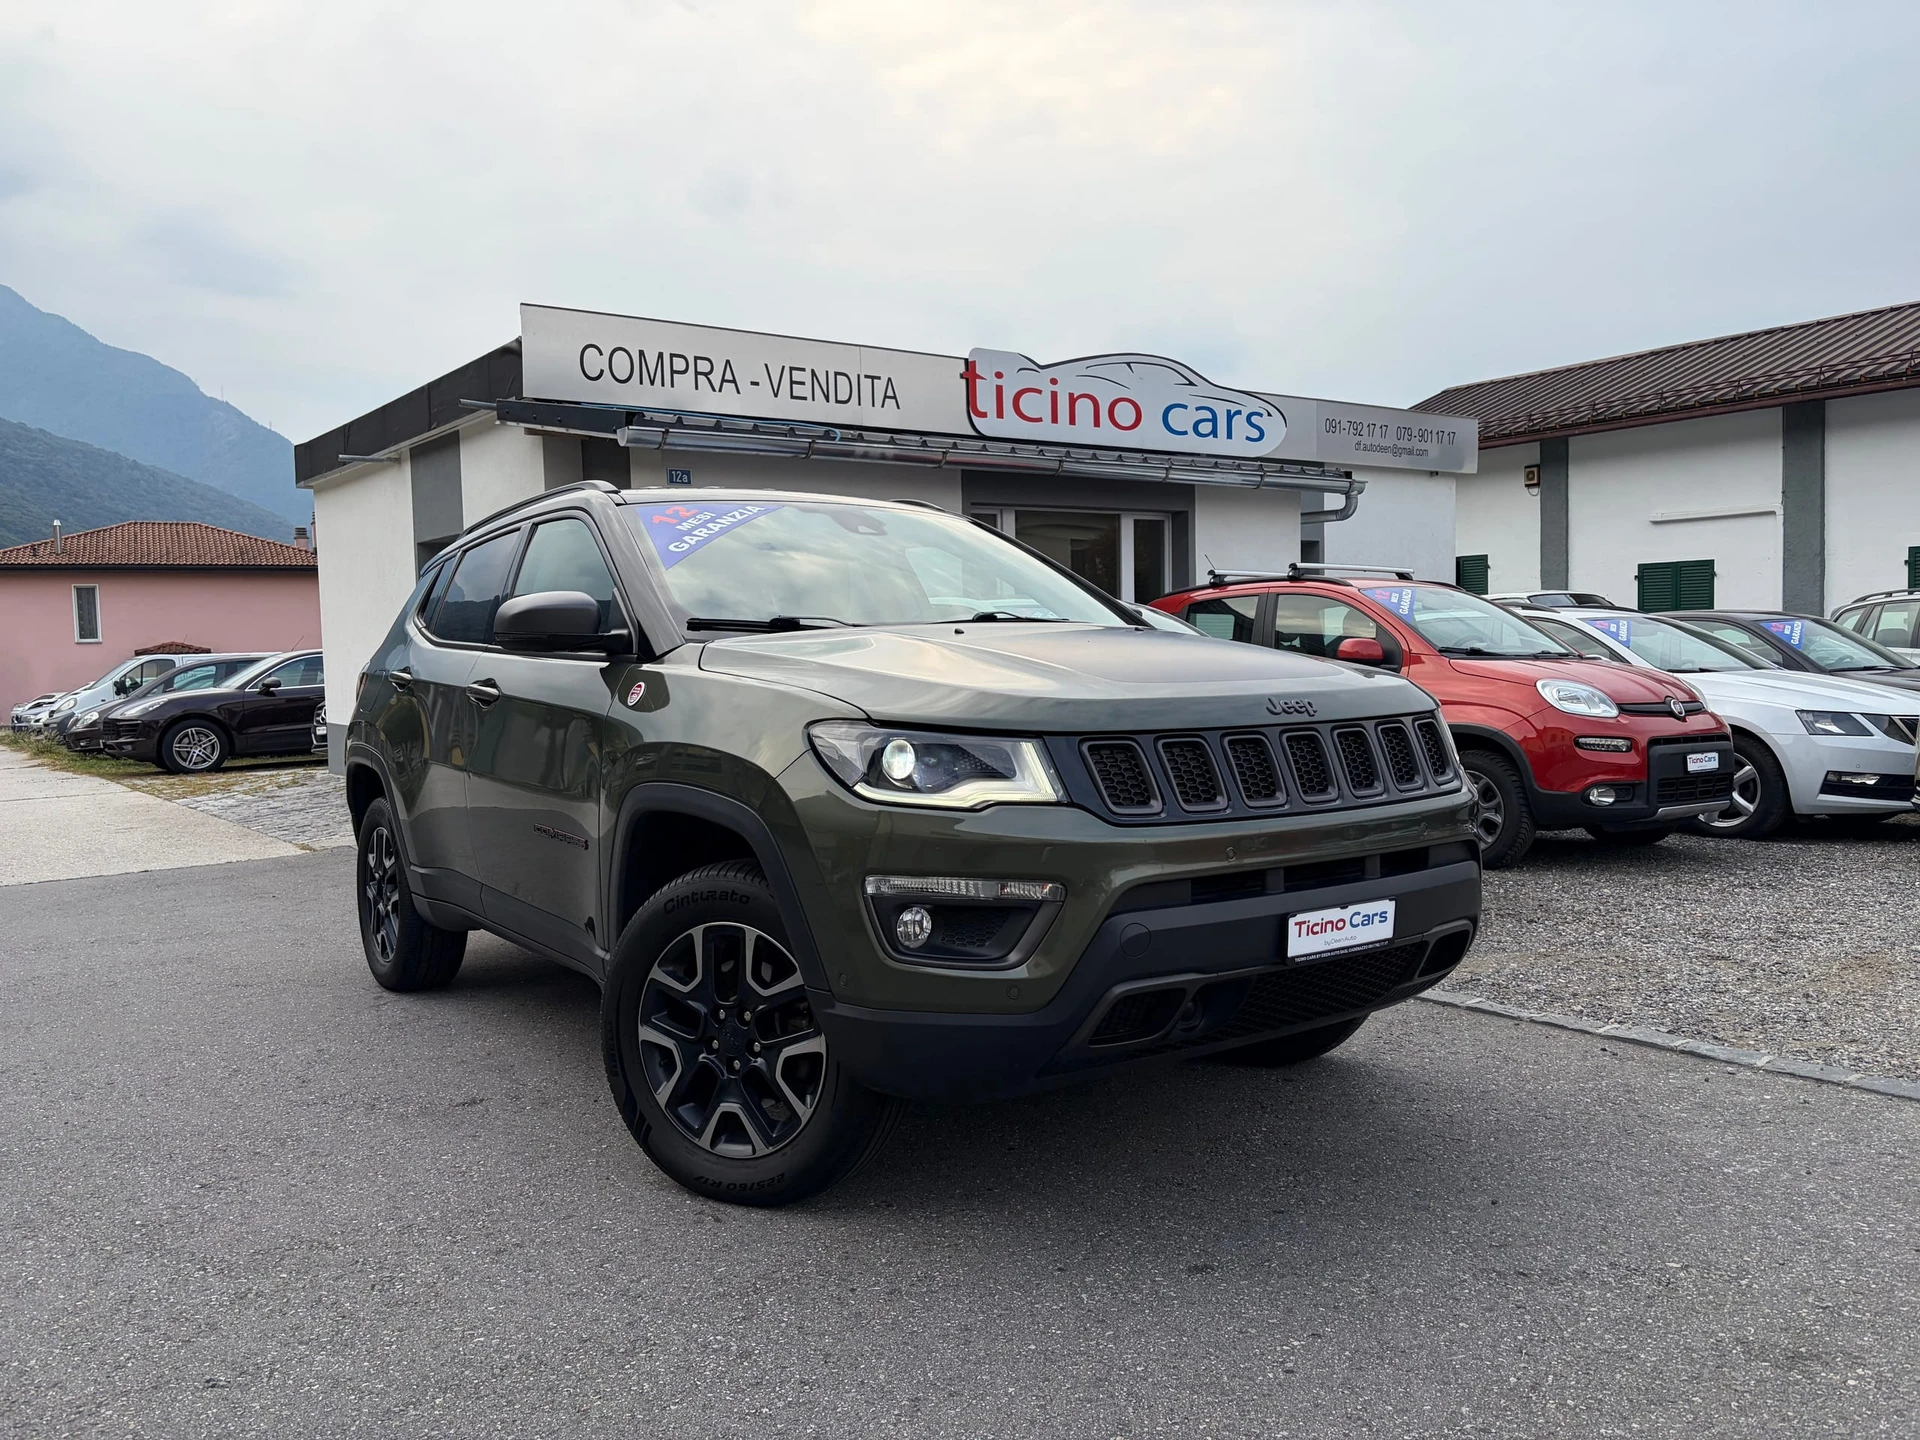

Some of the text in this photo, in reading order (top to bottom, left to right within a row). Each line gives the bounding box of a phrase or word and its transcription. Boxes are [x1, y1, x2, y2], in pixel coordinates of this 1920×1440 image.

[960, 359, 1267, 442] ticino cars
[1325, 418, 1456, 446] 091-792 17 17 079-901 17 17
[671, 471, 689, 483] 12a
[652, 505, 700, 525] 12
[675, 511, 717, 532] MESI
[667, 505, 767, 553] GARANZIA
[1266, 697, 1318, 718] Jeep
[1294, 910, 1389, 938] Ticino Cars
